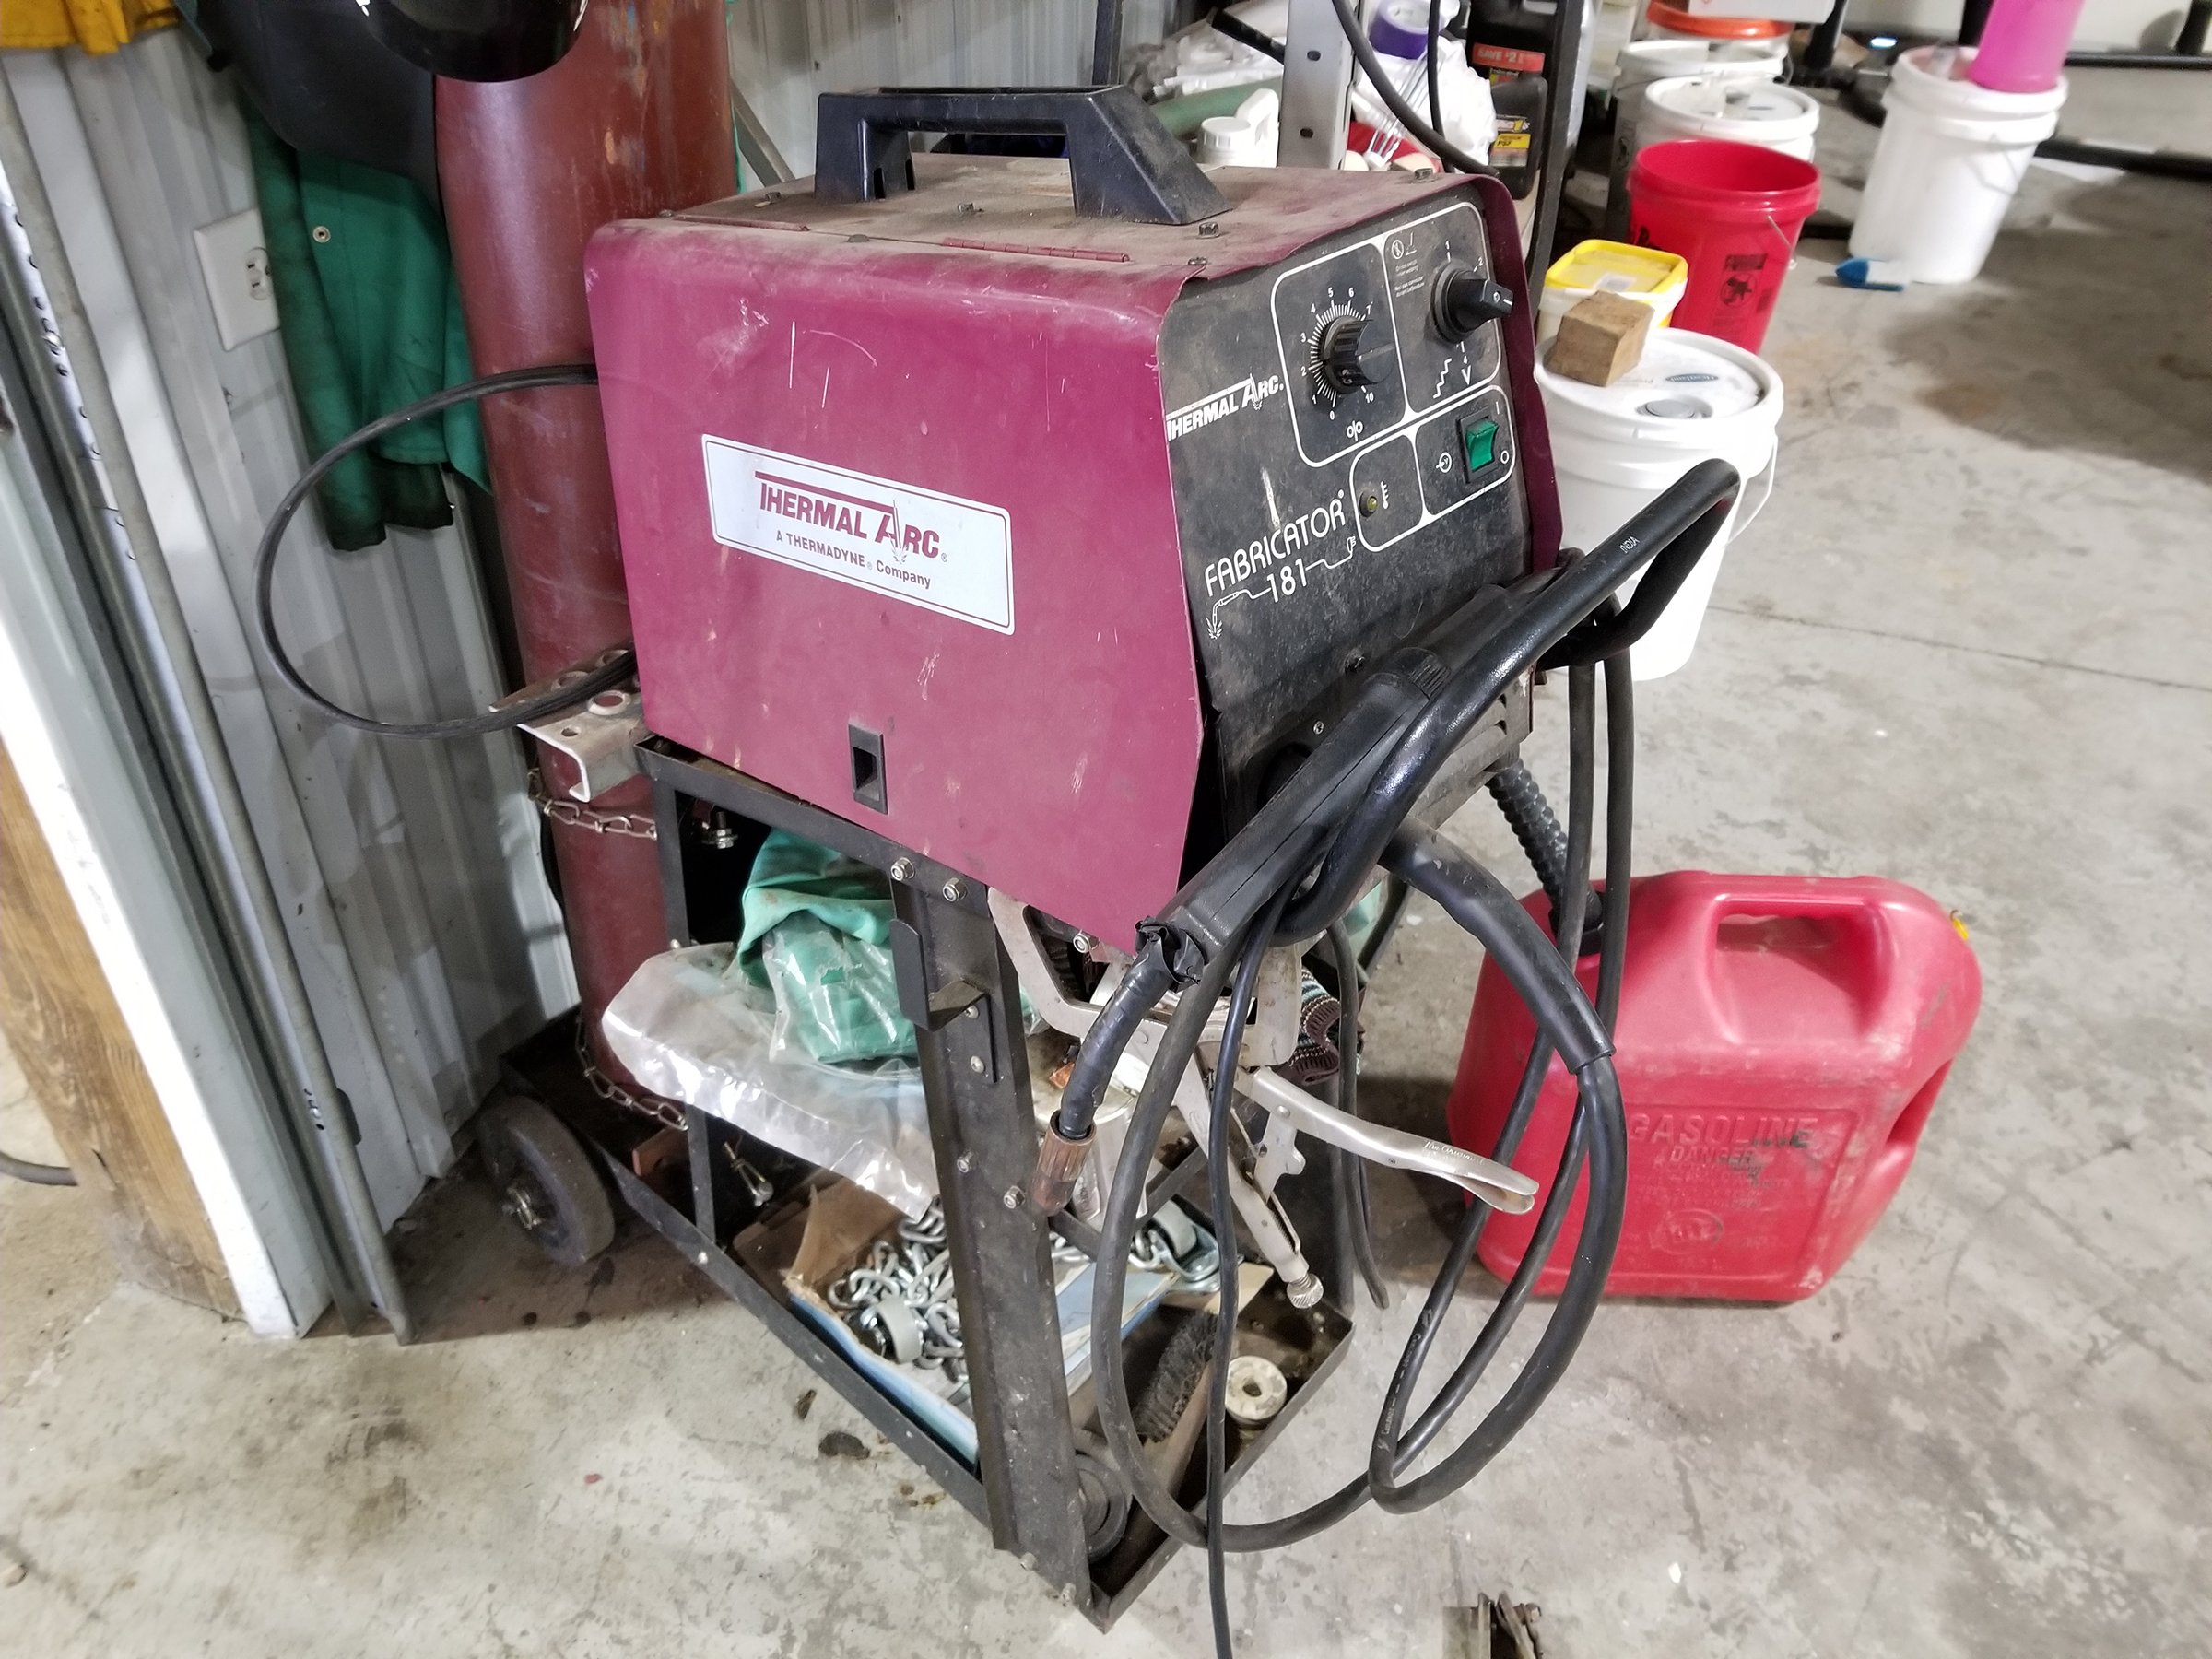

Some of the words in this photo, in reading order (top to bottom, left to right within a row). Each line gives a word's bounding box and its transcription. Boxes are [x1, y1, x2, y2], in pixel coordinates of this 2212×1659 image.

[1327, 287, 1334, 298] 5
[1348, 287, 1355, 298] 6
[1310, 303, 1316, 313] 4
[1300, 333, 1307, 343] 3
[1300, 366, 1307, 377] 2
[1365, 392, 1374, 404] 10
[755, 471, 867, 540] THERMAL
[1205, 499, 1346, 597] FABRICATOR
[776, 530, 783, 543] A
[785, 533, 865, 568] THERMADYNE
[876, 559, 931, 590] Company
[1266, 558, 1308, 603] 181
[1629, 1113, 1818, 1148] GASOLINE
